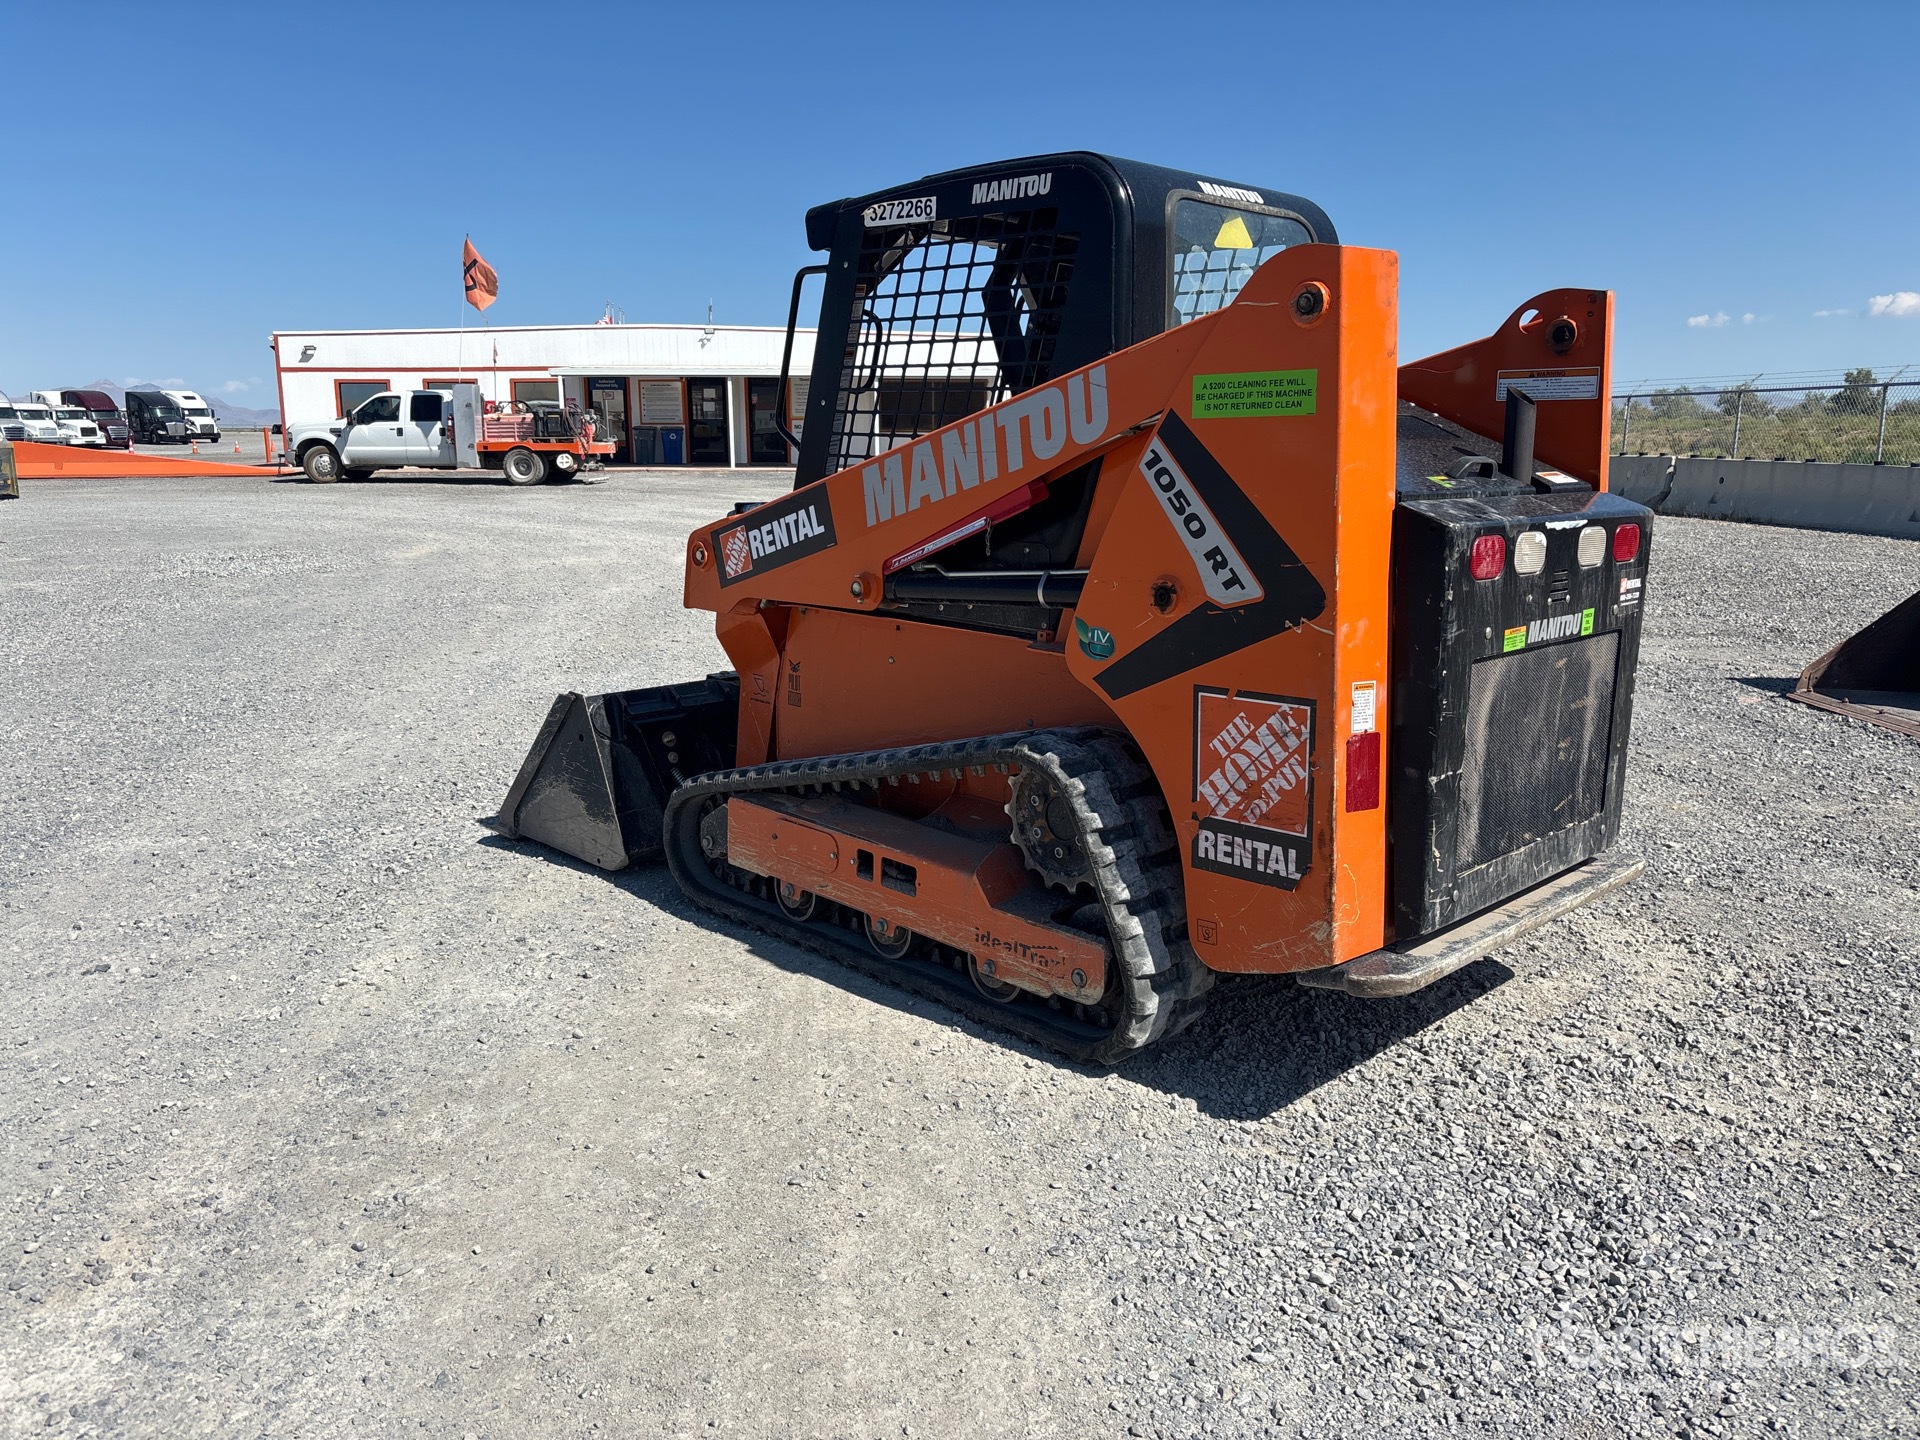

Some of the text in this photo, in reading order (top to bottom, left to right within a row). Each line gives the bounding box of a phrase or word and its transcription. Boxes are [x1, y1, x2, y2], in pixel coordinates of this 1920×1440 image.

[971, 172, 1053, 205] MANITOU
[1196, 180, 1265, 205] MANITOU
[866, 198, 934, 222] 3272266
[1195, 388, 1313, 401] BE CHARGED IF THIS MACHINE
[1209, 381, 1226, 390] $200
[1227, 379, 1267, 389] CLEANING
[1269, 378, 1285, 387] FEE
[1286, 378, 1307, 386] WILL
[1204, 400, 1303, 411] IS NOT RETURNED CLEAN
[862, 364, 1109, 528] MANITOU
[748, 504, 826, 560] RENTAL
[1144, 448, 1246, 592] 1050 RT
[1527, 612, 1582, 644] MANITOU
[1208, 711, 1255, 759] THE
[1199, 703, 1310, 818] HOME
[1240, 753, 1308, 824] DEPOT
[1197, 828, 1302, 881] RENTAL
